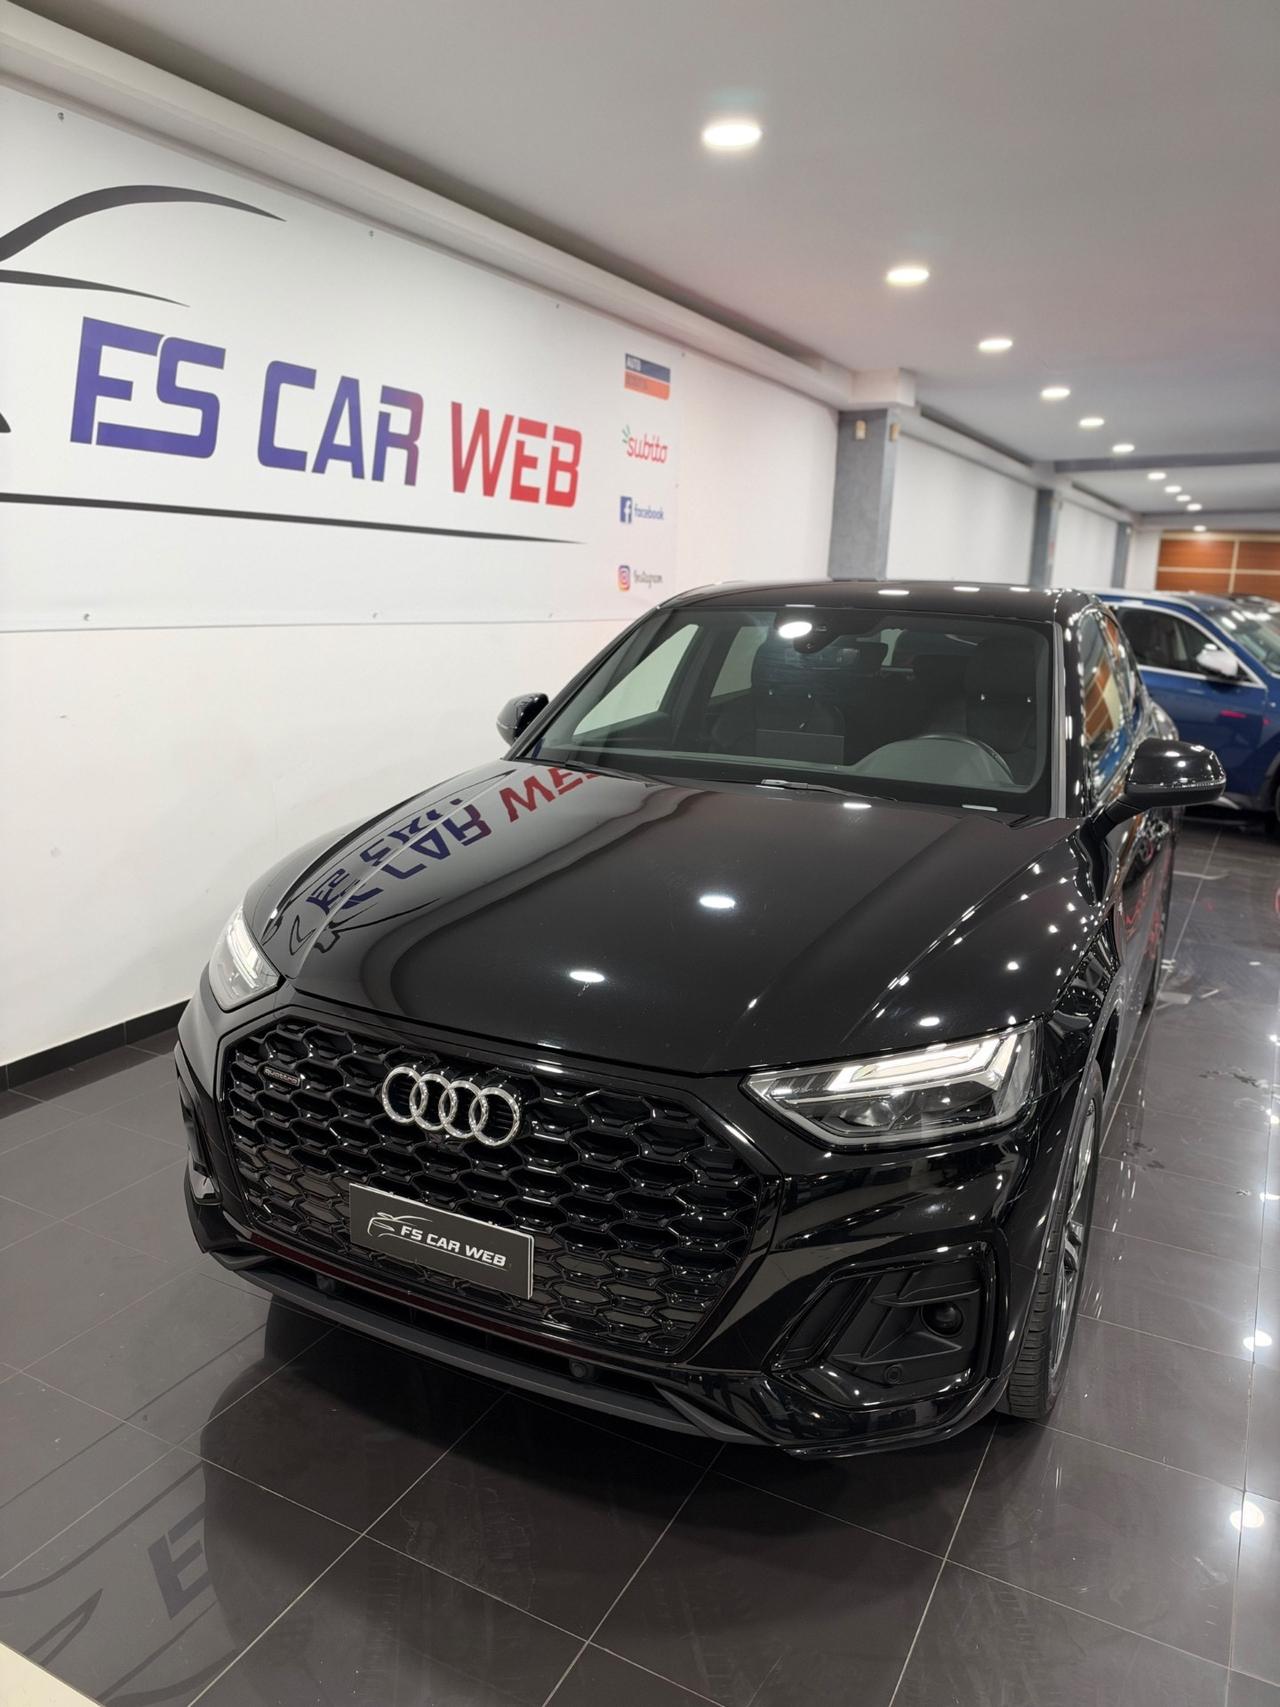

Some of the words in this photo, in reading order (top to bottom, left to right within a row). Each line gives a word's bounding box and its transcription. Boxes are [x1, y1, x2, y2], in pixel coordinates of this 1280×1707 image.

[70, 316, 226, 458] FS
[257, 360, 424, 486] CAR
[450, 401, 583, 508] WEB
[627, 433, 668, 464] subito
[634, 504, 664, 520] facebook
[401, 1225, 423, 1241] FS
[426, 1233, 460, 1253] CAR
[465, 1244, 506, 1267] WEB
